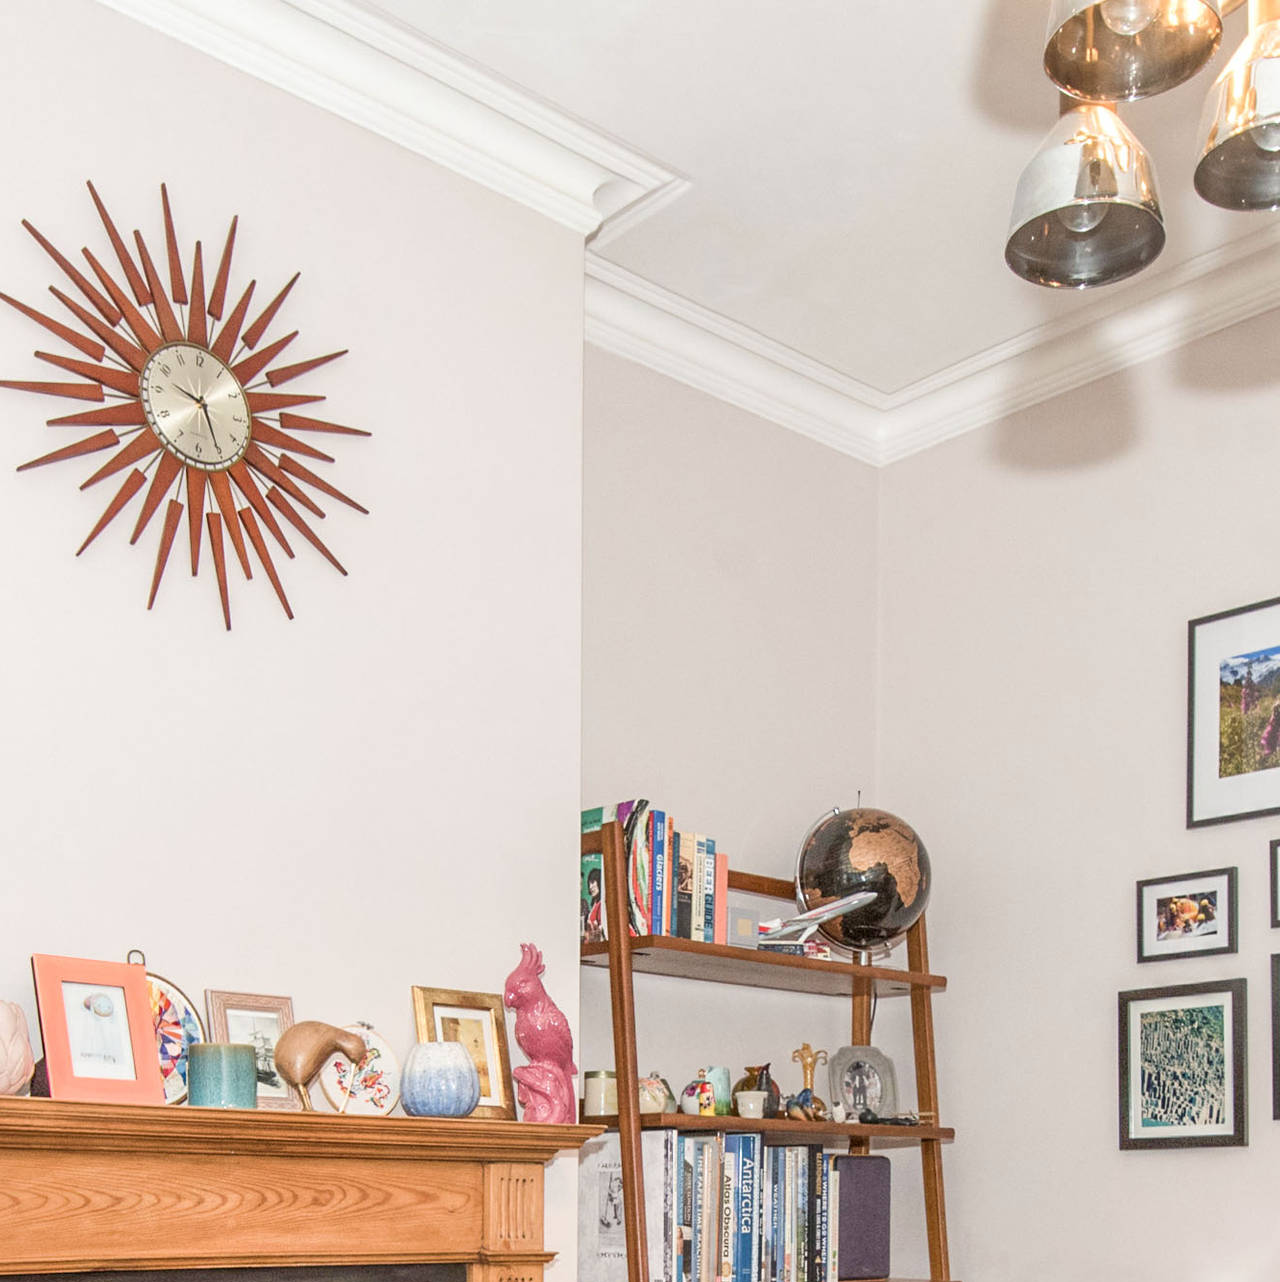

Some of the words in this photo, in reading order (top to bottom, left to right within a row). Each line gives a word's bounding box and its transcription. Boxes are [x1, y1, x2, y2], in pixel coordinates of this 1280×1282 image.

[176, 354, 185, 365] 11
[196, 356, 204, 368] 12
[160, 365, 171, 377] 10
[216, 368, 224, 379] 1
[160, 410, 170, 418] 8
[230, 434, 237, 442] 4
[195, 443, 202, 453] 6
[656, 854, 664, 891] Glaciers
[704, 894, 713, 928] GUIDE
[722, 1175, 732, 1204] Atlas
[741, 1158, 754, 1233] Antarctica
[722, 1207, 731, 1258] Obscura
